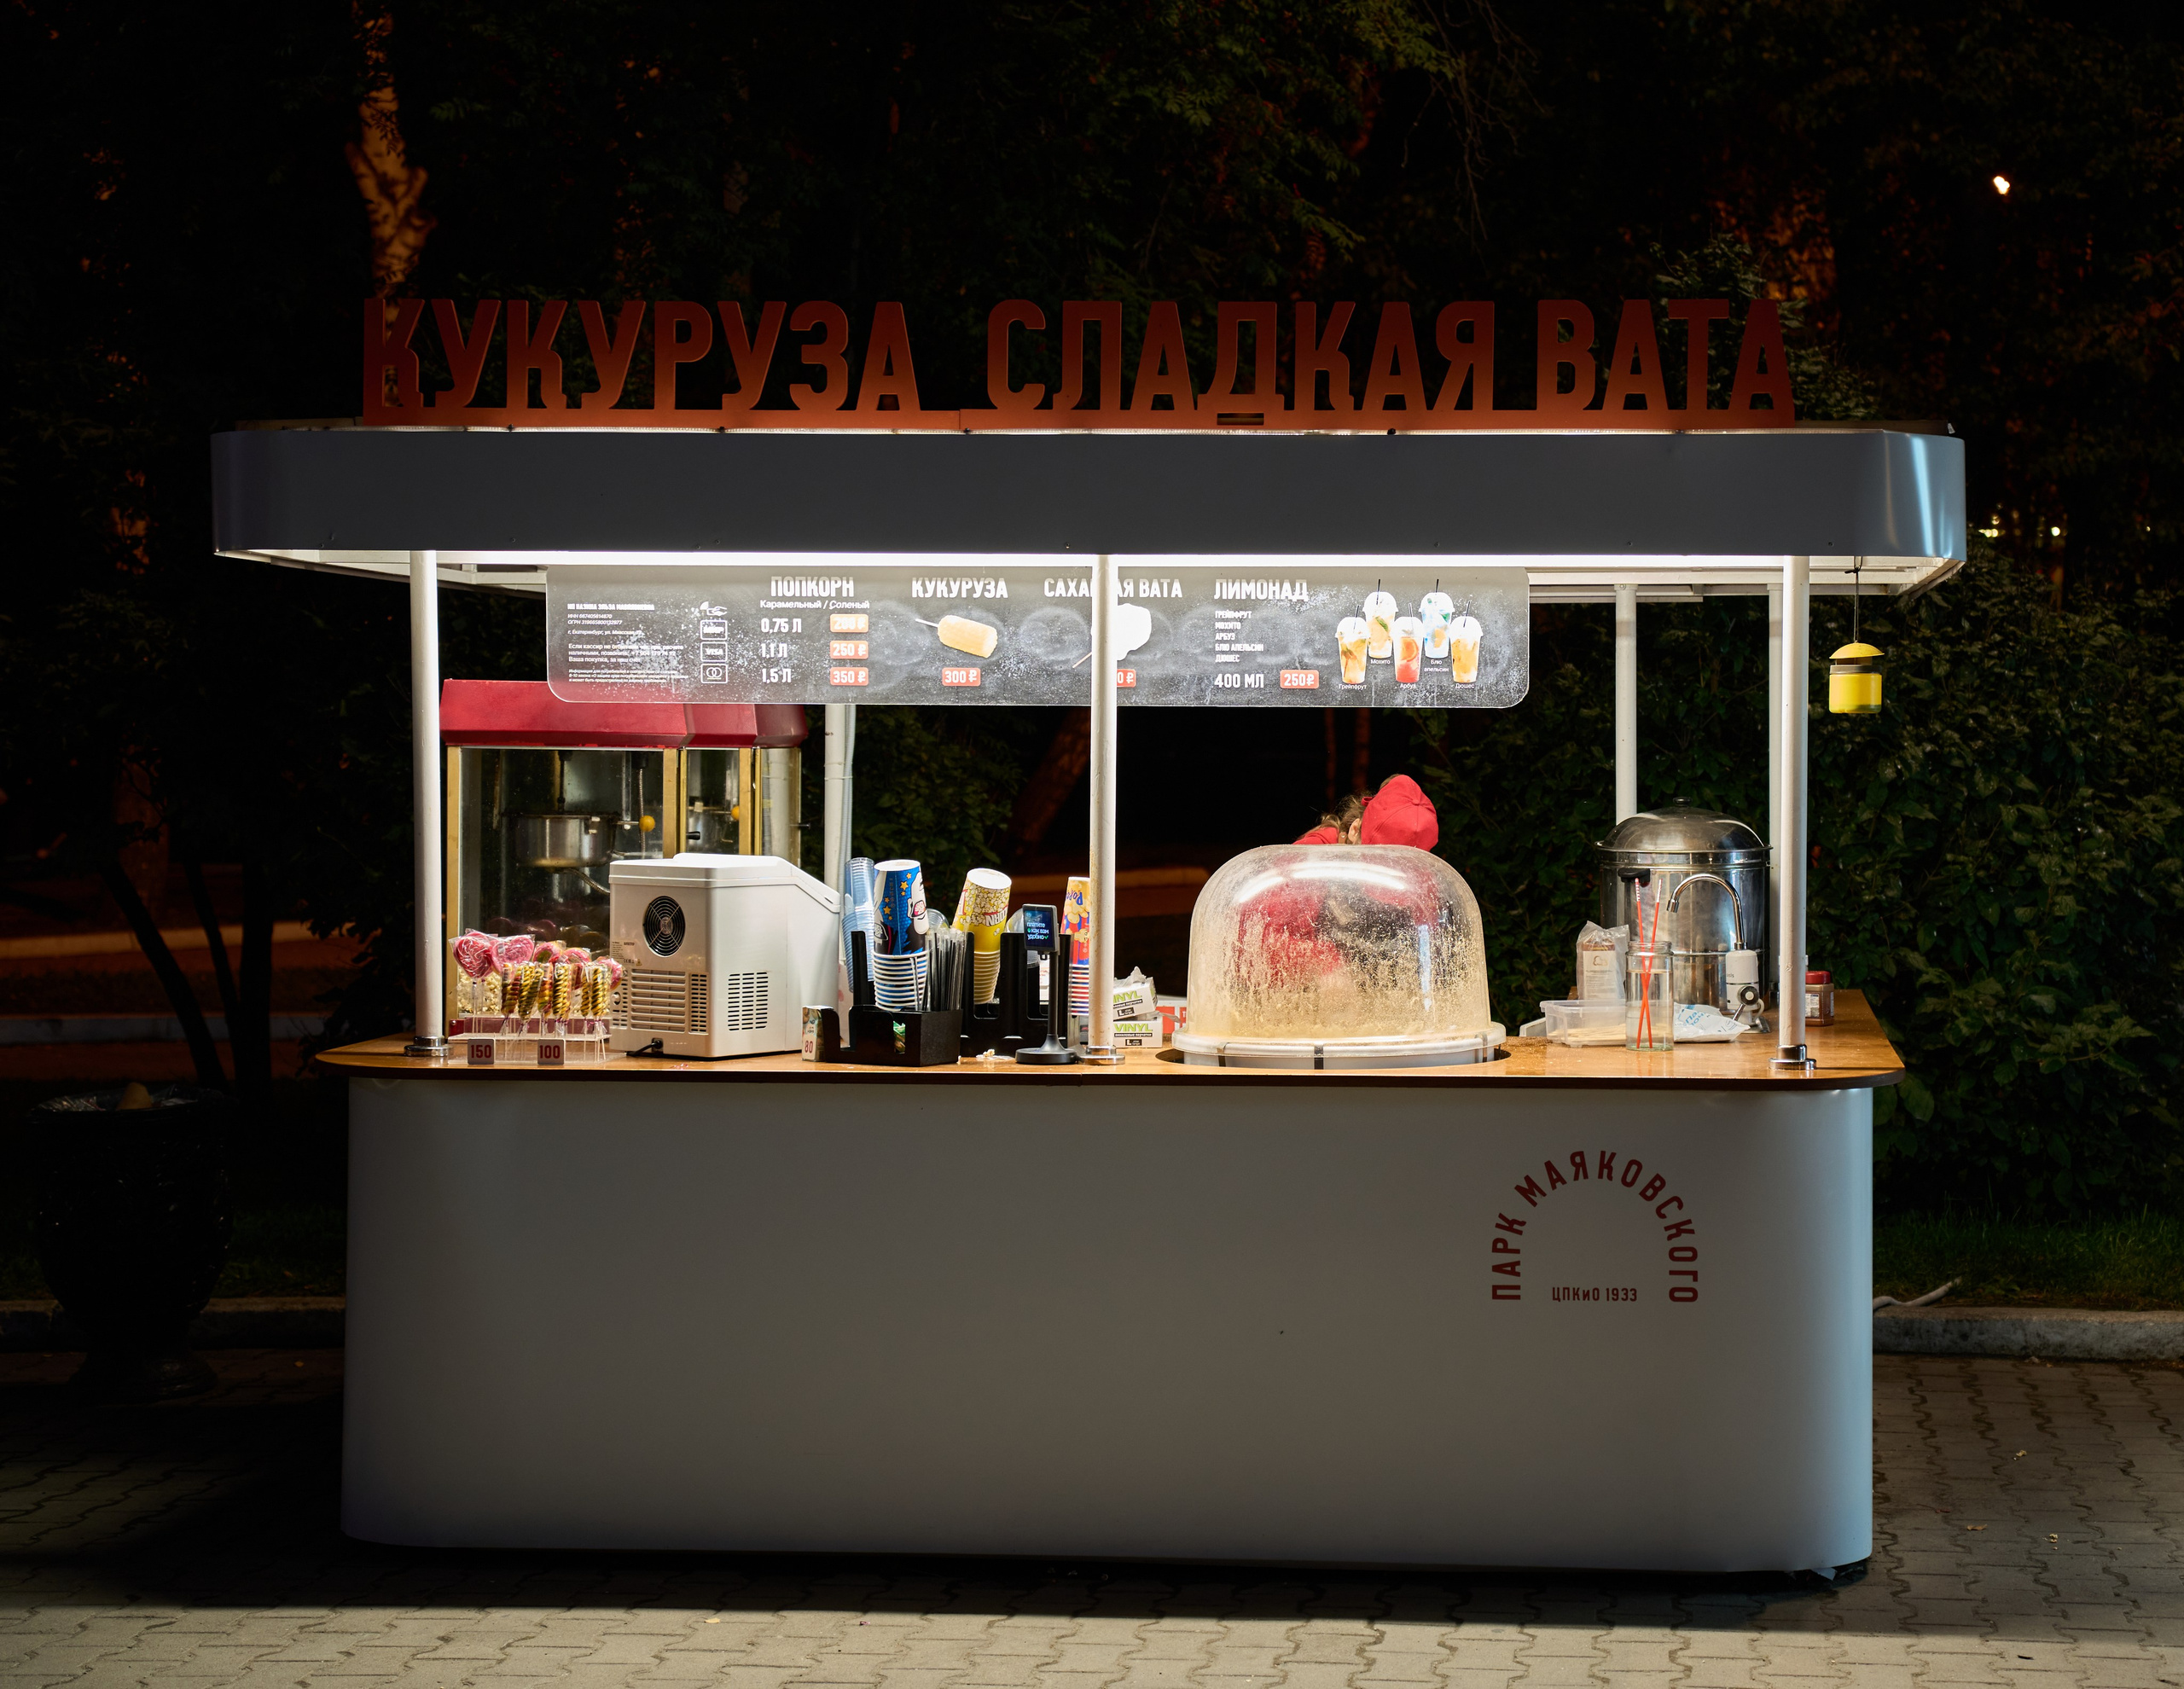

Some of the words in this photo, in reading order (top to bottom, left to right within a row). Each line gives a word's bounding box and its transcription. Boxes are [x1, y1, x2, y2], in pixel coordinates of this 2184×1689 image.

[363, 299, 921, 413] КУКУРУЗА
[987, 299, 1494, 413] СЛАДКАЯ
[1537, 299, 1794, 413] ВАТА
[770, 576, 855, 597] ПОПКОРН
[912, 578, 1008, 599] КУКУРУЗА
[1139, 578, 1182, 598] ВАТА
[1213, 579, 1309, 602] ЛИМОНАД
[760, 600, 822, 609] Карамельный
[828, 600, 870, 609] Соленый
[1215, 610, 1252, 618] ГРЕЙПФРУТ
[761, 618, 789, 634] 0,75
[792, 618, 802, 633] Л
[1215, 632, 1235, 641] АРБУЗ
[761, 643, 775, 659] 1,1
[777, 643, 787, 658] Л
[833, 643, 855, 657] 250
[1215, 643, 1230, 652] БЛЮ
[1230, 643, 1263, 652] АПЕЛЬСИН
[1215, 654, 1240, 663] ДЮШЕС
[762, 668, 779, 683] 1,5
[782, 668, 792, 683] Л
[833, 670, 855, 683] 350
[857, 670, 866, 683] ₽
[944, 670, 967, 683] 300
[968, 670, 978, 683] ₽
[1214, 673, 1241, 688] 400
[1244, 673, 1264, 688] МЛ
[1113, 990, 1142, 1004] INYL
[1114, 1023, 1153, 1032] VINYL
[471, 1044, 492, 1059] 150
[539, 1045, 561, 1059] 100
[804, 1040, 814, 1054] 80
[1491, 1212, 1527, 1301] ПАРК
[1513, 1150, 1699, 1303] МАЯКОВСКОГО
[1552, 1286, 1600, 1303] ЦПКиО
[1606, 1287, 1638, 1303] 1933
